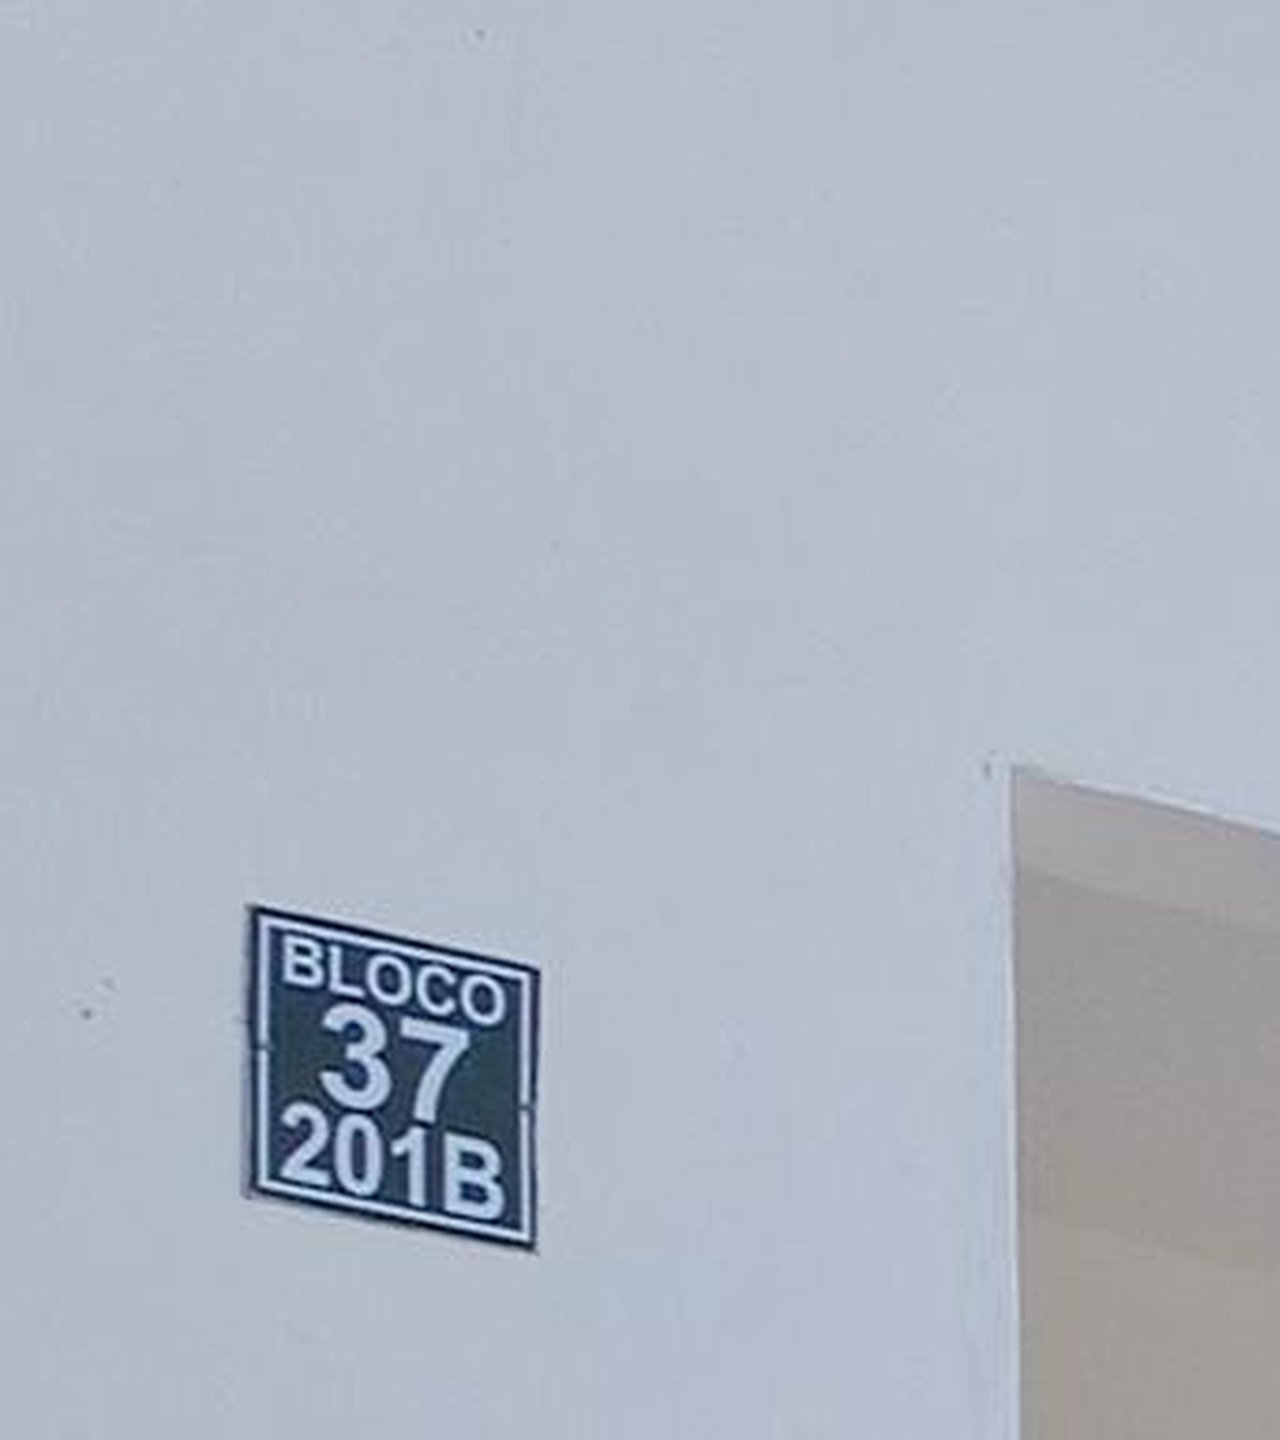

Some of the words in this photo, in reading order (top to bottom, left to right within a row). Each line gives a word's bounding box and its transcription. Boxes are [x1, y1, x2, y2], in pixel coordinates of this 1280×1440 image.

[281, 933, 507, 1028] BLOCO
[319, 1001, 471, 1124] 37
[279, 1100, 506, 1221] 201B
